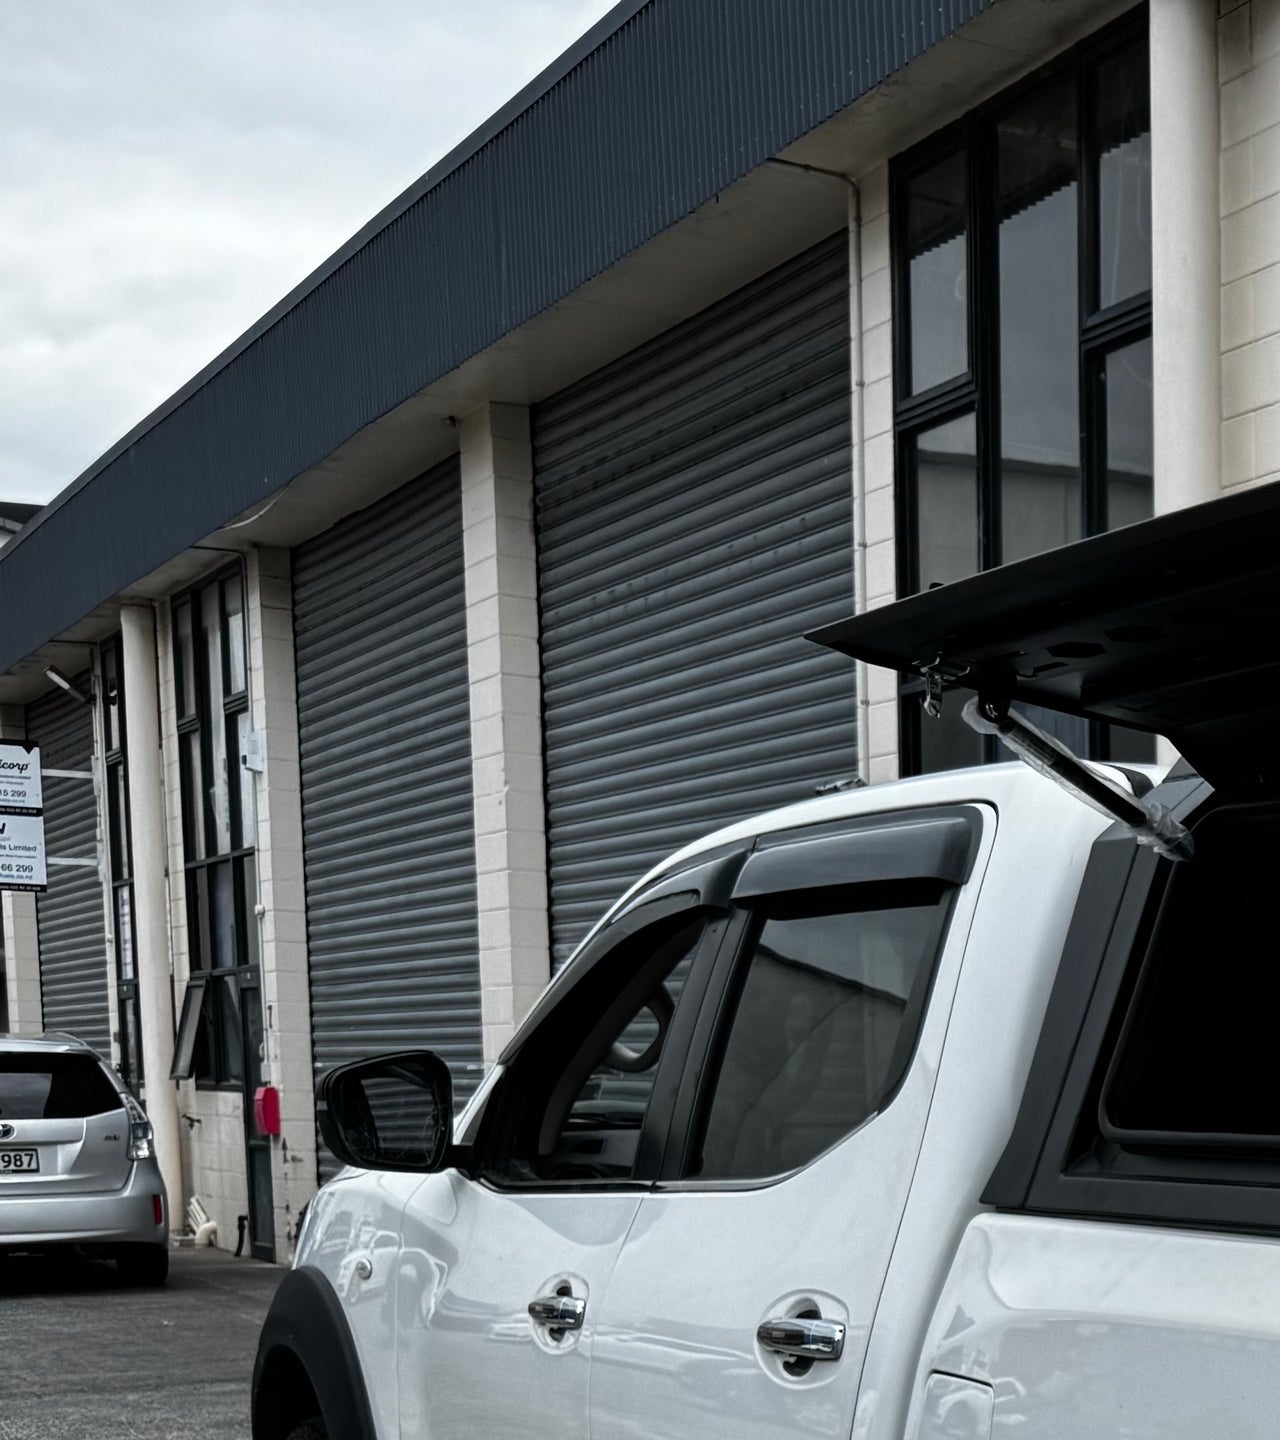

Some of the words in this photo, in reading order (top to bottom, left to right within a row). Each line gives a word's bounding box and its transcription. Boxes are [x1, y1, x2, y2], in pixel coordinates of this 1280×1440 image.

[8, 843, 37, 852] Limited
[15, 864, 33, 873] 299
[1, 1153, 34, 1168] 987
